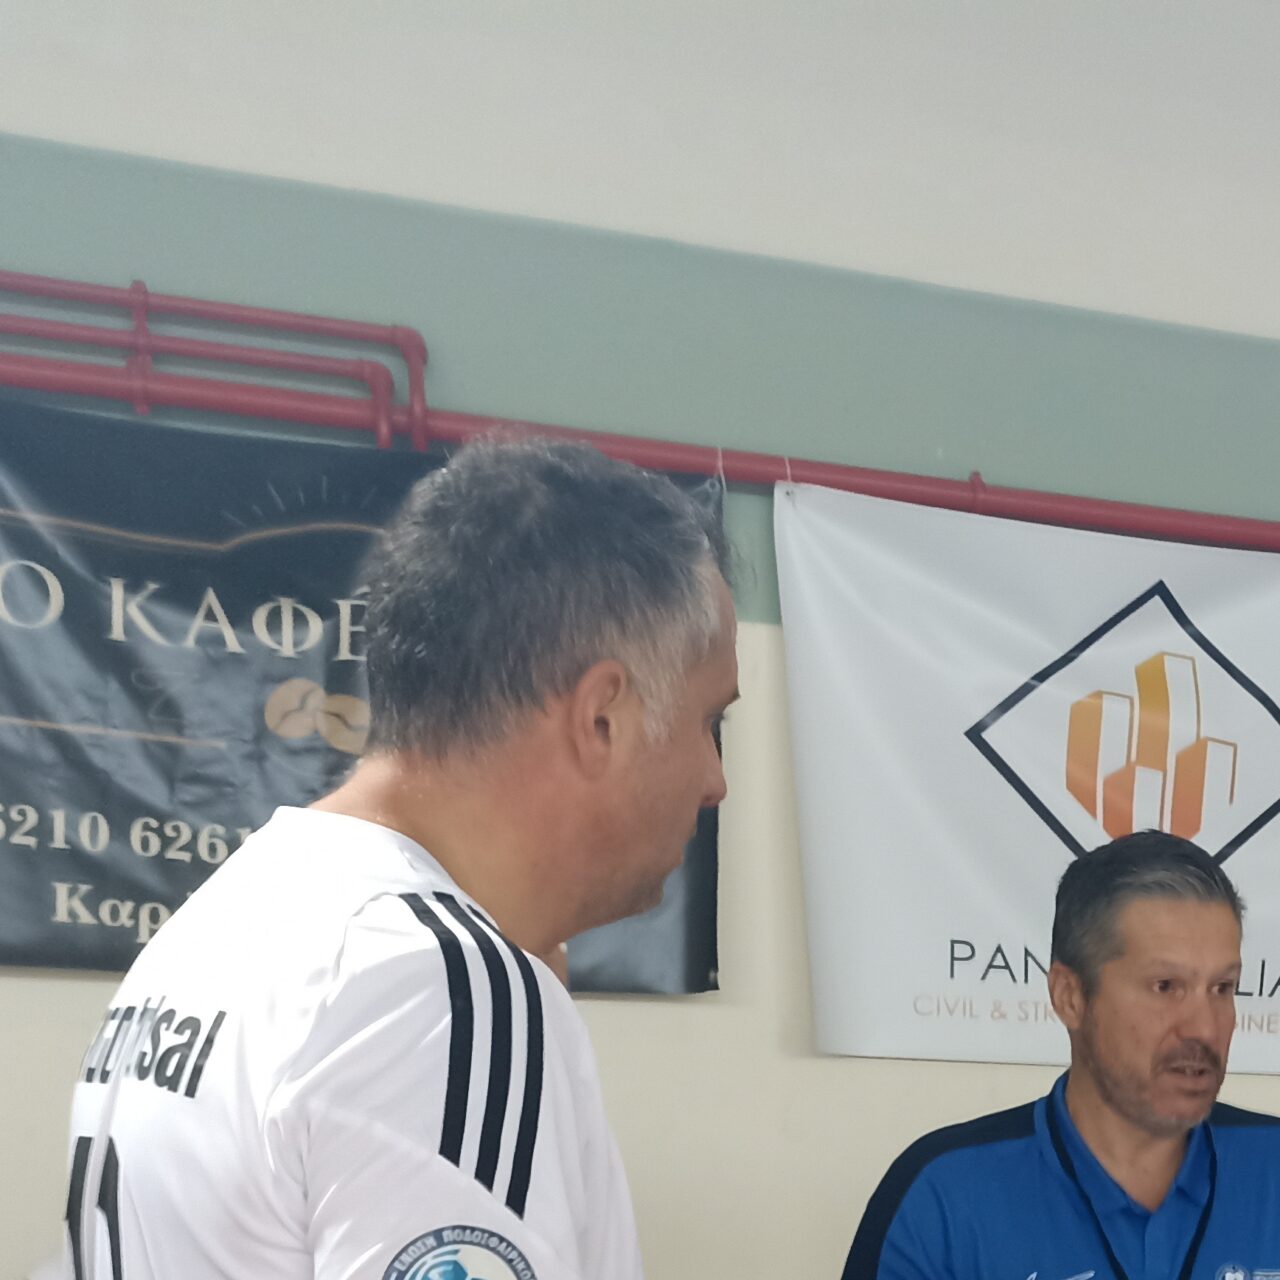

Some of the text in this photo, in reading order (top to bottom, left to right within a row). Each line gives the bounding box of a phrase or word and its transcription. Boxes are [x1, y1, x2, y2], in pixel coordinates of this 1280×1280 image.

[0, 803, 252, 864] 210 626
[913, 994, 979, 1019] CIVIL
[990, 1000, 1008, 1020] &
